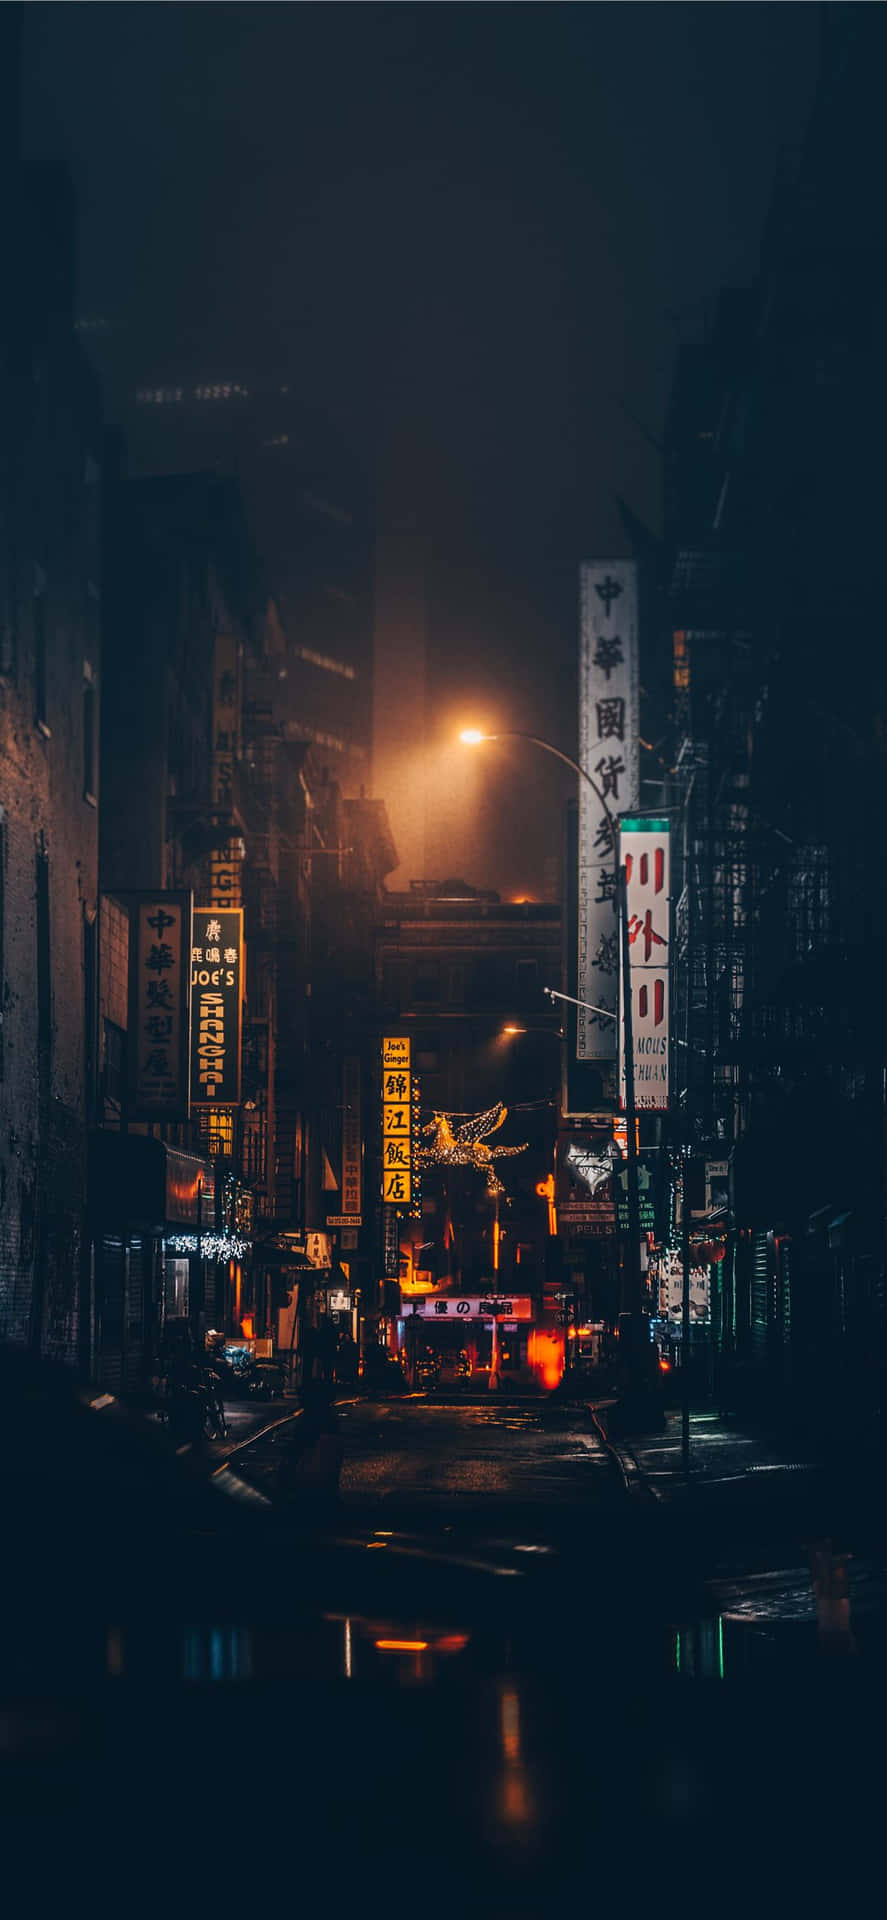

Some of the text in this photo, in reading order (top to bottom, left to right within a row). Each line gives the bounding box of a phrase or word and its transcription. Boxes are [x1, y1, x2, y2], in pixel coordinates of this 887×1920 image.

[191, 968, 235, 986] JOE'S
[197, 992, 227, 1096] SHANGHAI
[387, 1041, 406, 1051] Joe's
[384, 1054, 409, 1066] Ginger
[385, 1073, 409, 1201] 錦江飯店
